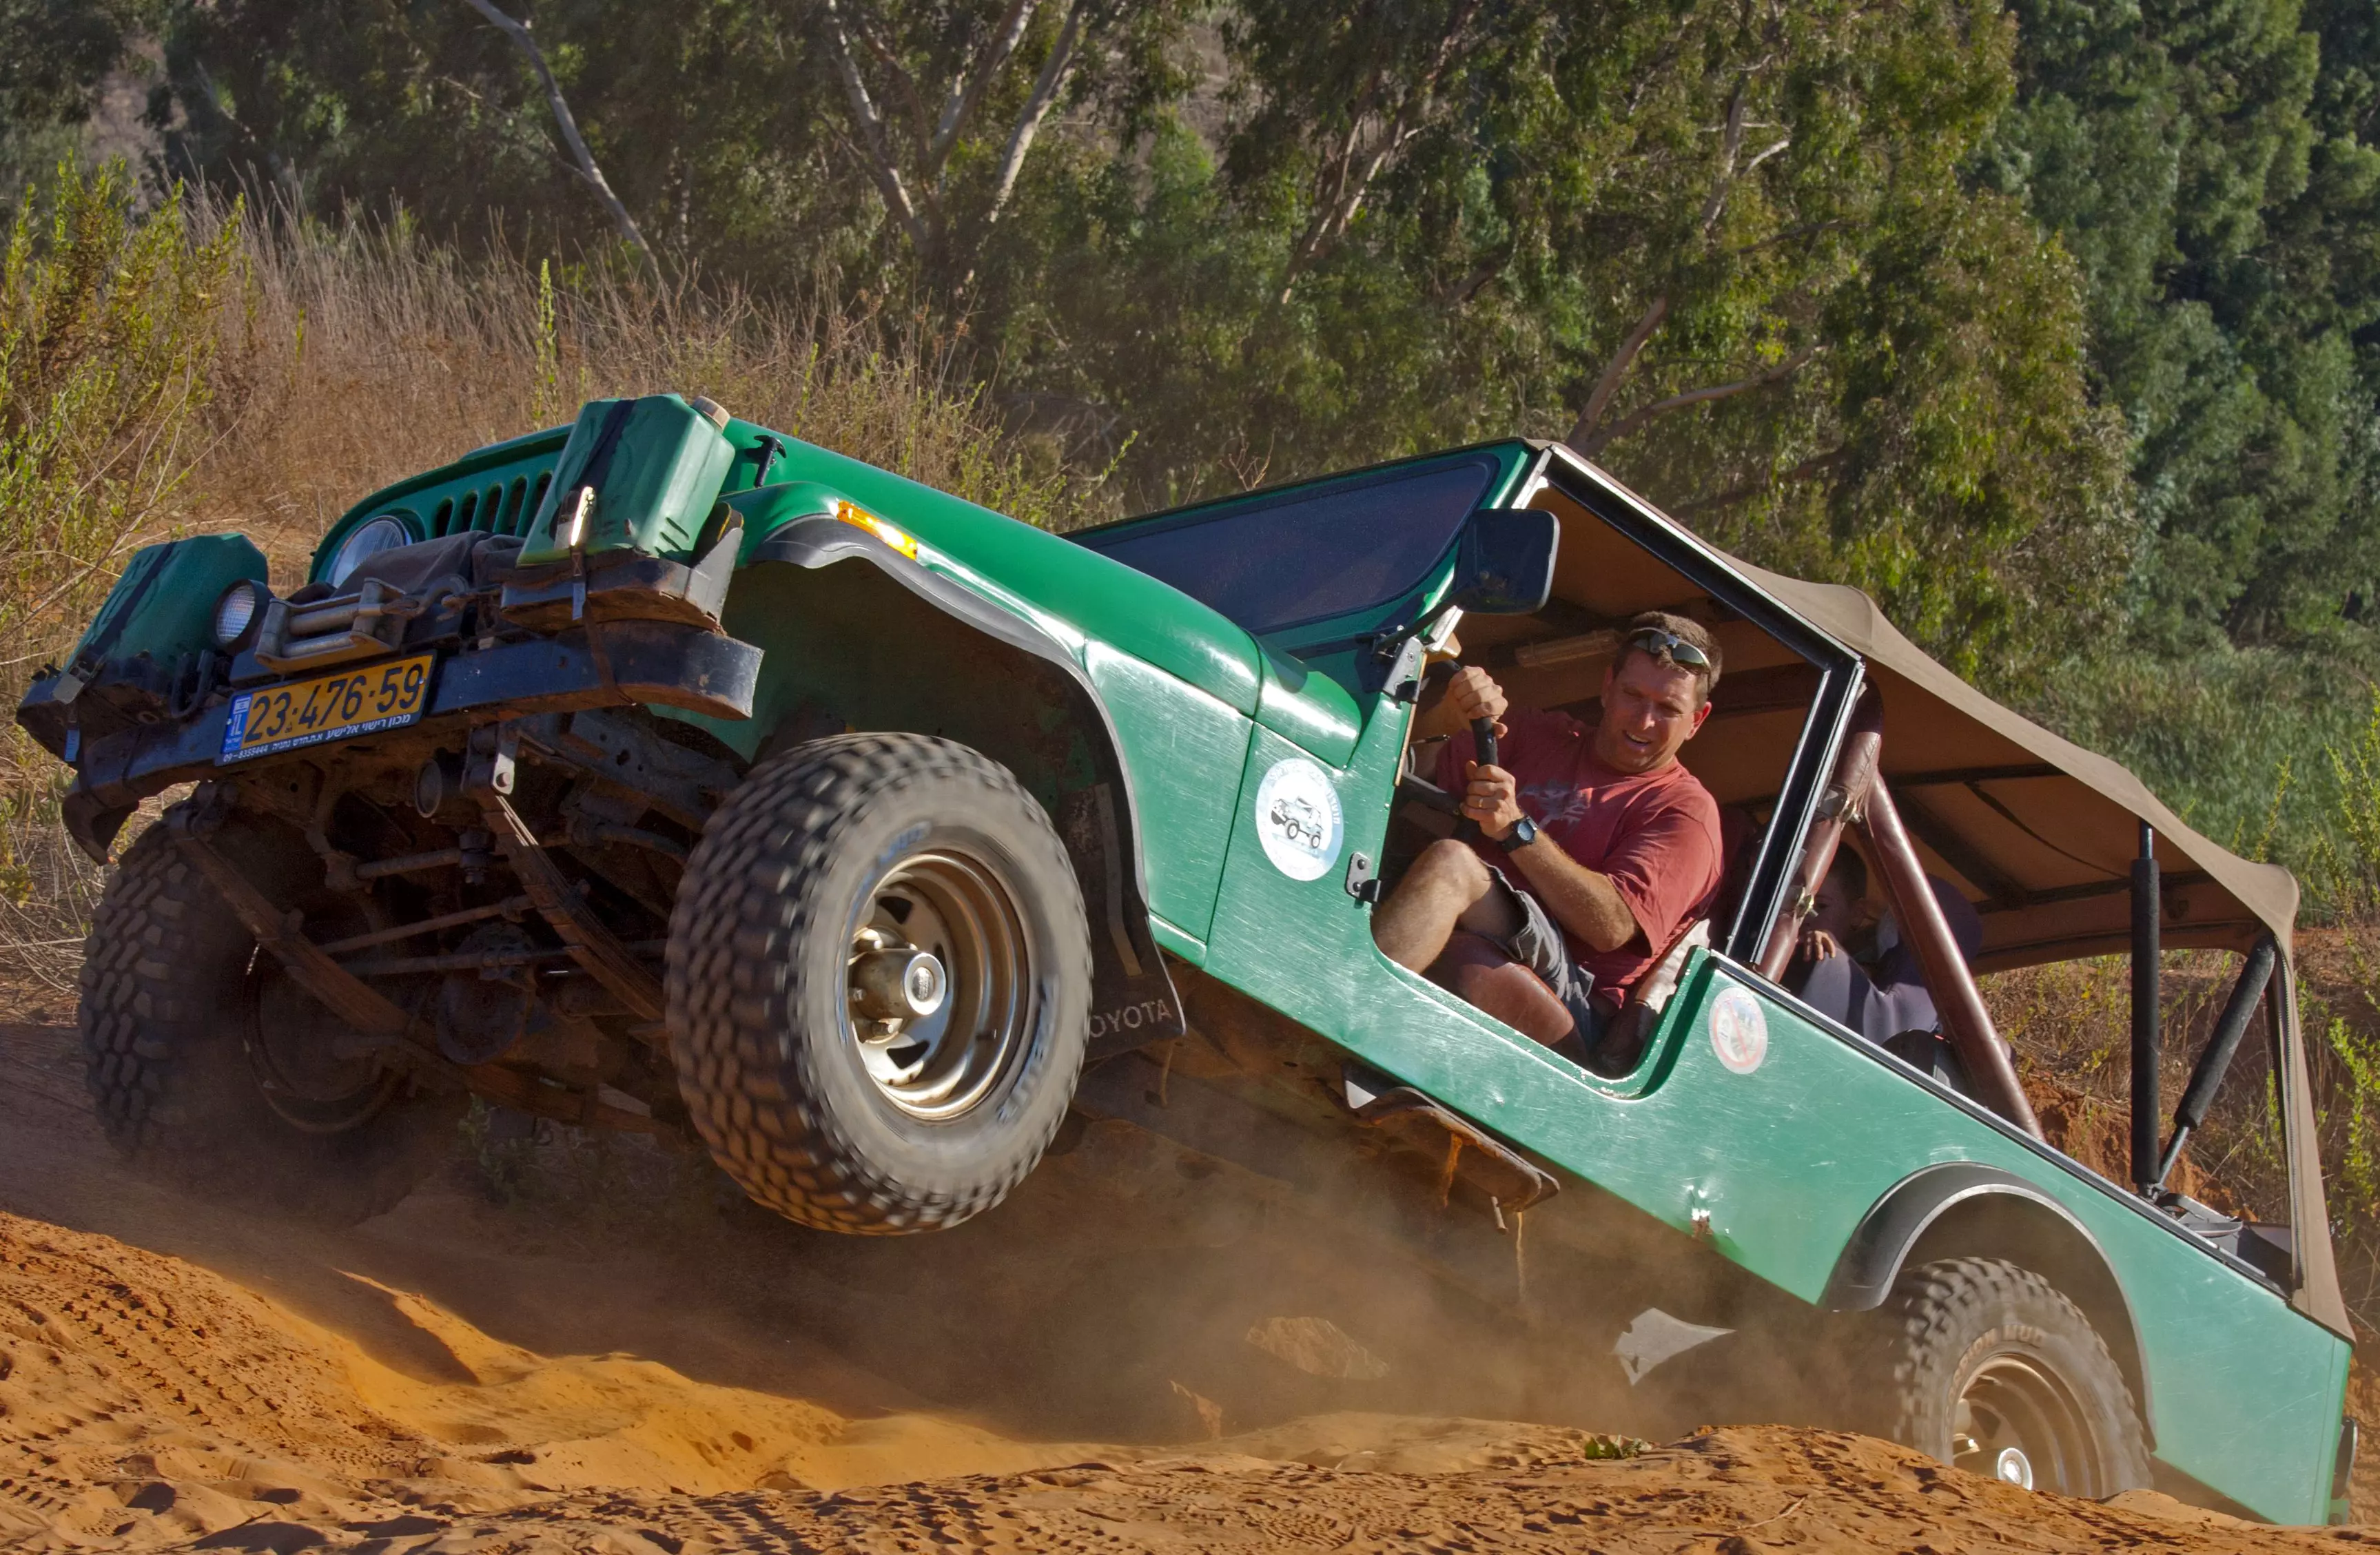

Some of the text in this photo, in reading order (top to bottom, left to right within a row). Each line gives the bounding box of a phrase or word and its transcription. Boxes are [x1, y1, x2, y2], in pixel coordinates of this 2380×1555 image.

[229, 713, 243, 737] IL
[362, 718, 387, 731] רישוי
[389, 713, 411, 728] מכון
[325, 723, 360, 740] אלישע
[271, 739, 291, 751] נתניה
[1089, 998, 1172, 1038] OYOTA
